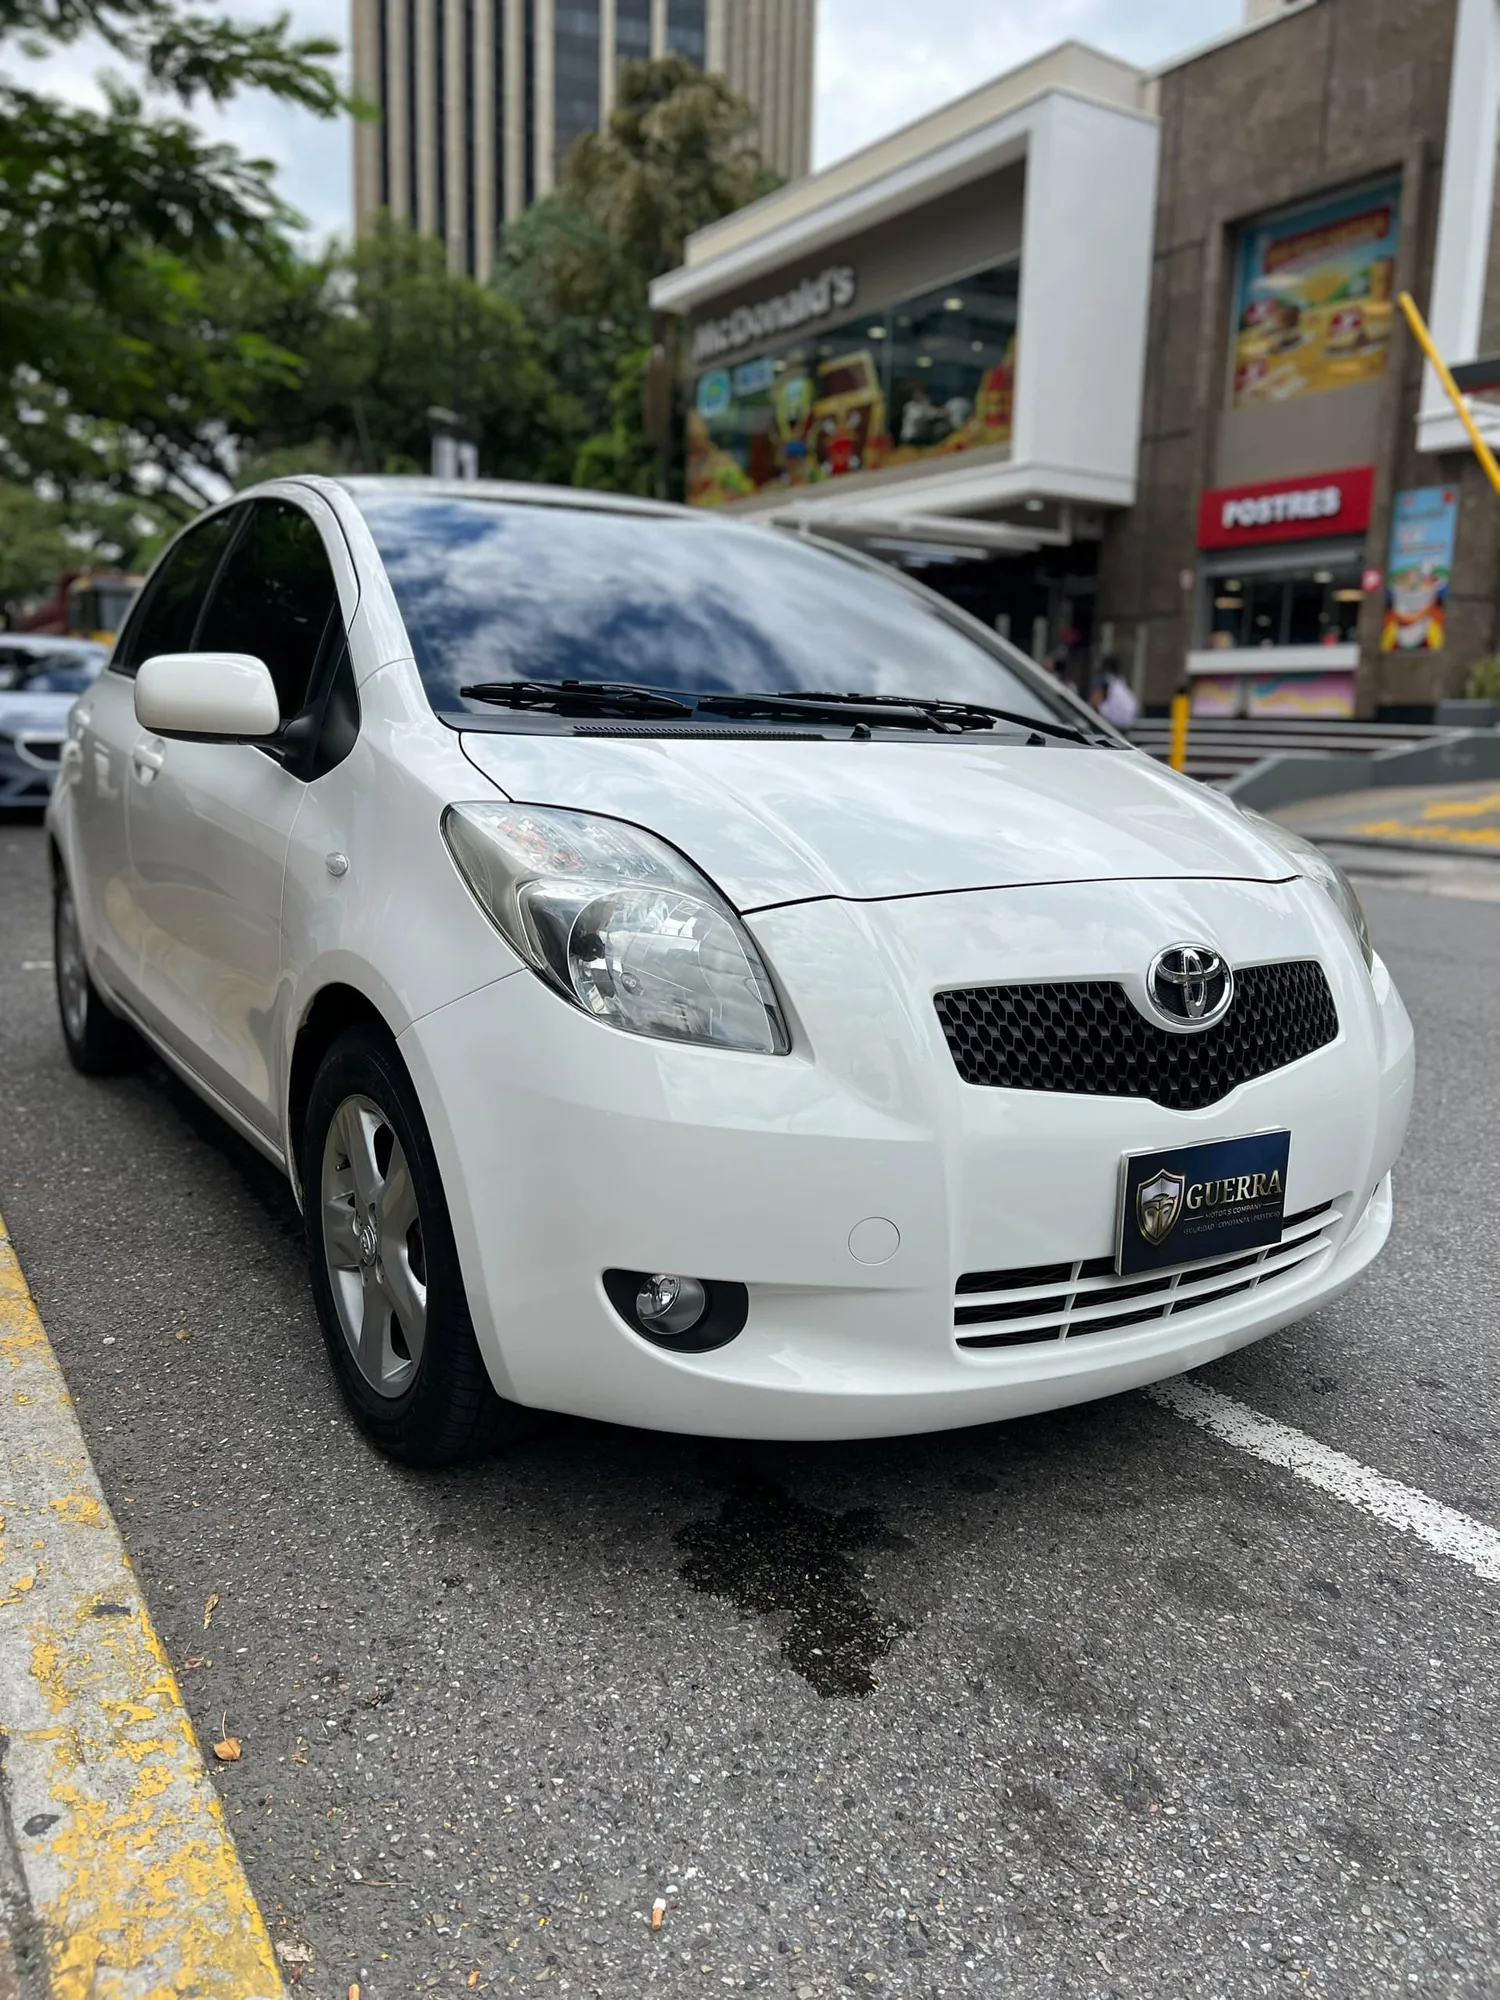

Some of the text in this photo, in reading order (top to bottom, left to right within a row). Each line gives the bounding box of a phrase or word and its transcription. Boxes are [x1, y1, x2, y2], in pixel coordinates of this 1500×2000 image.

[695, 266, 855, 360] McDonald's
[1221, 486, 1341, 529] POSTRES
[1186, 1170, 1283, 1209] GUERRA
[1232, 1203, 1263, 1215] COMPANY
